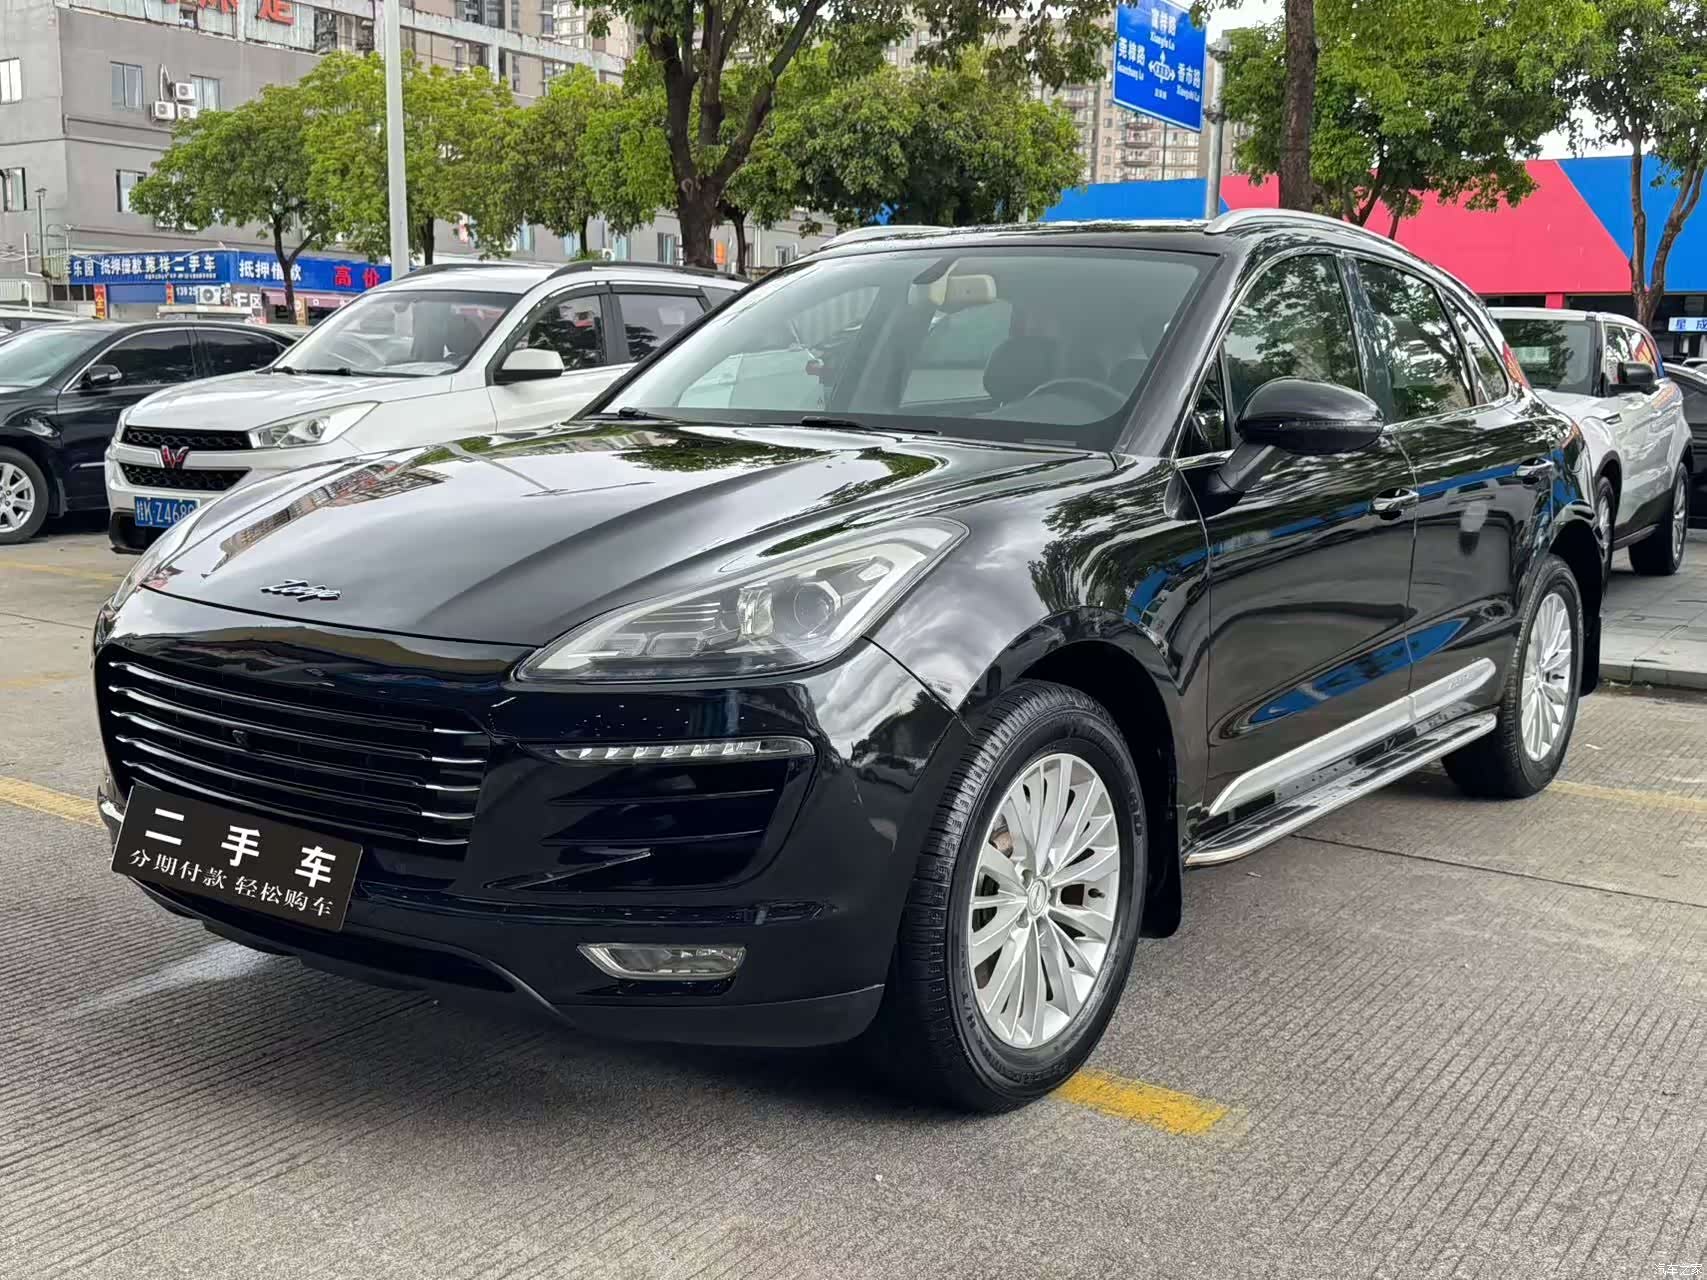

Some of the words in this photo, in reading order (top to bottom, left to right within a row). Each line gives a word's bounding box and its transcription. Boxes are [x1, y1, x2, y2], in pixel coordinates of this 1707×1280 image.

[333, 265, 380, 289] 高价
[145, 808, 336, 888] 二手车
[129, 849, 228, 889] 分期付款
[235, 875, 335, 917] 轻松购车
